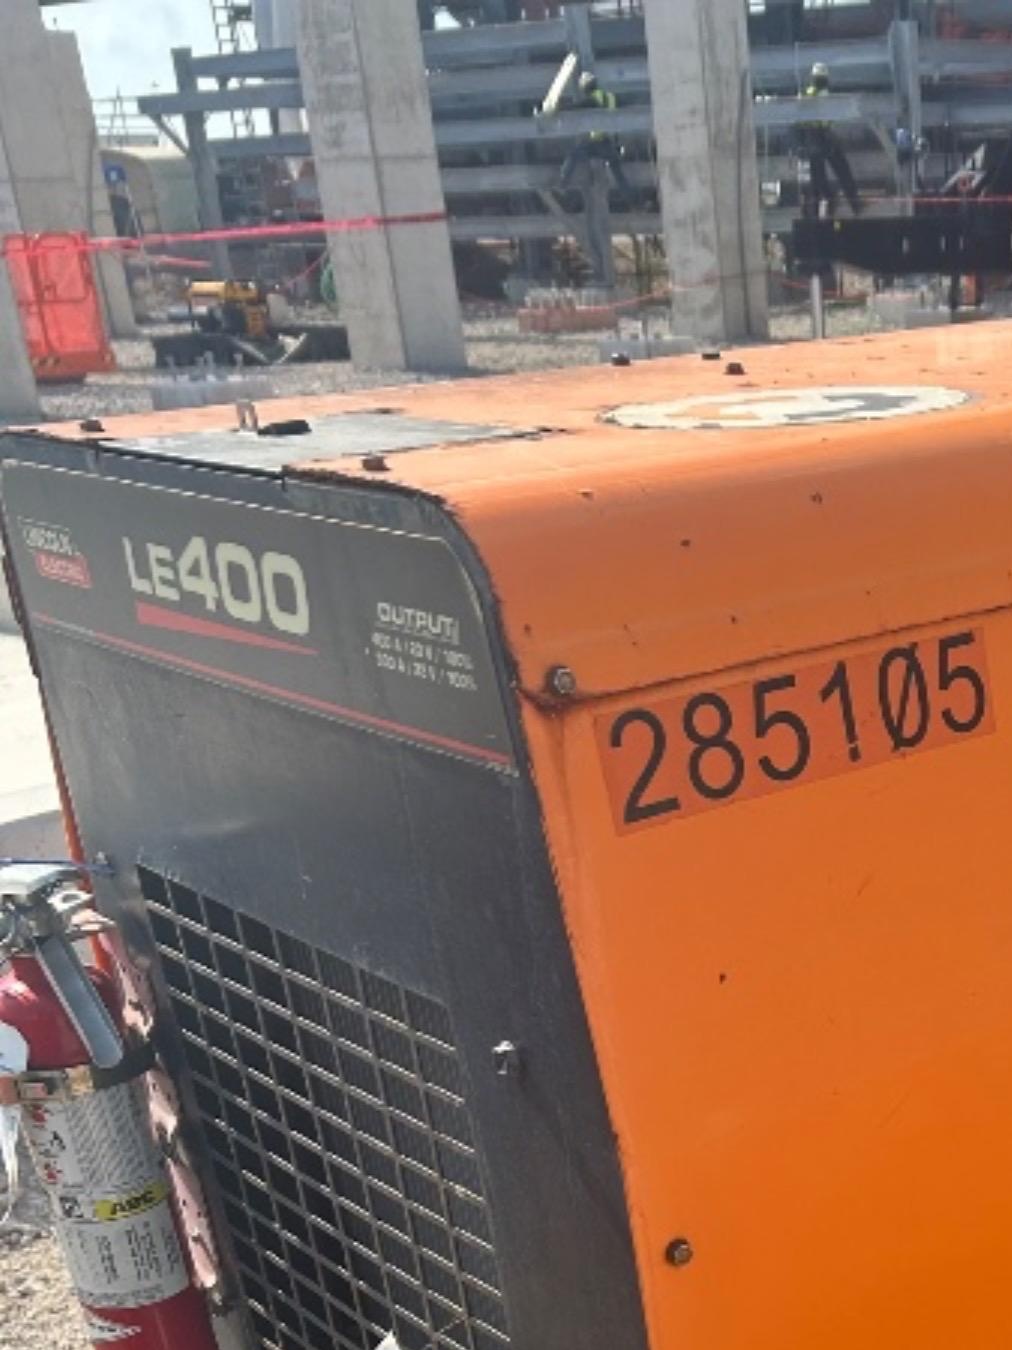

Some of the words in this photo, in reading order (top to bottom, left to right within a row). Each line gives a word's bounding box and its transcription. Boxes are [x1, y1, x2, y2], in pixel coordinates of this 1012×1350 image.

[122, 535, 311, 635] LE400
[377, 602, 456, 637] OUTPUT
[610, 630, 986, 824] 285105
